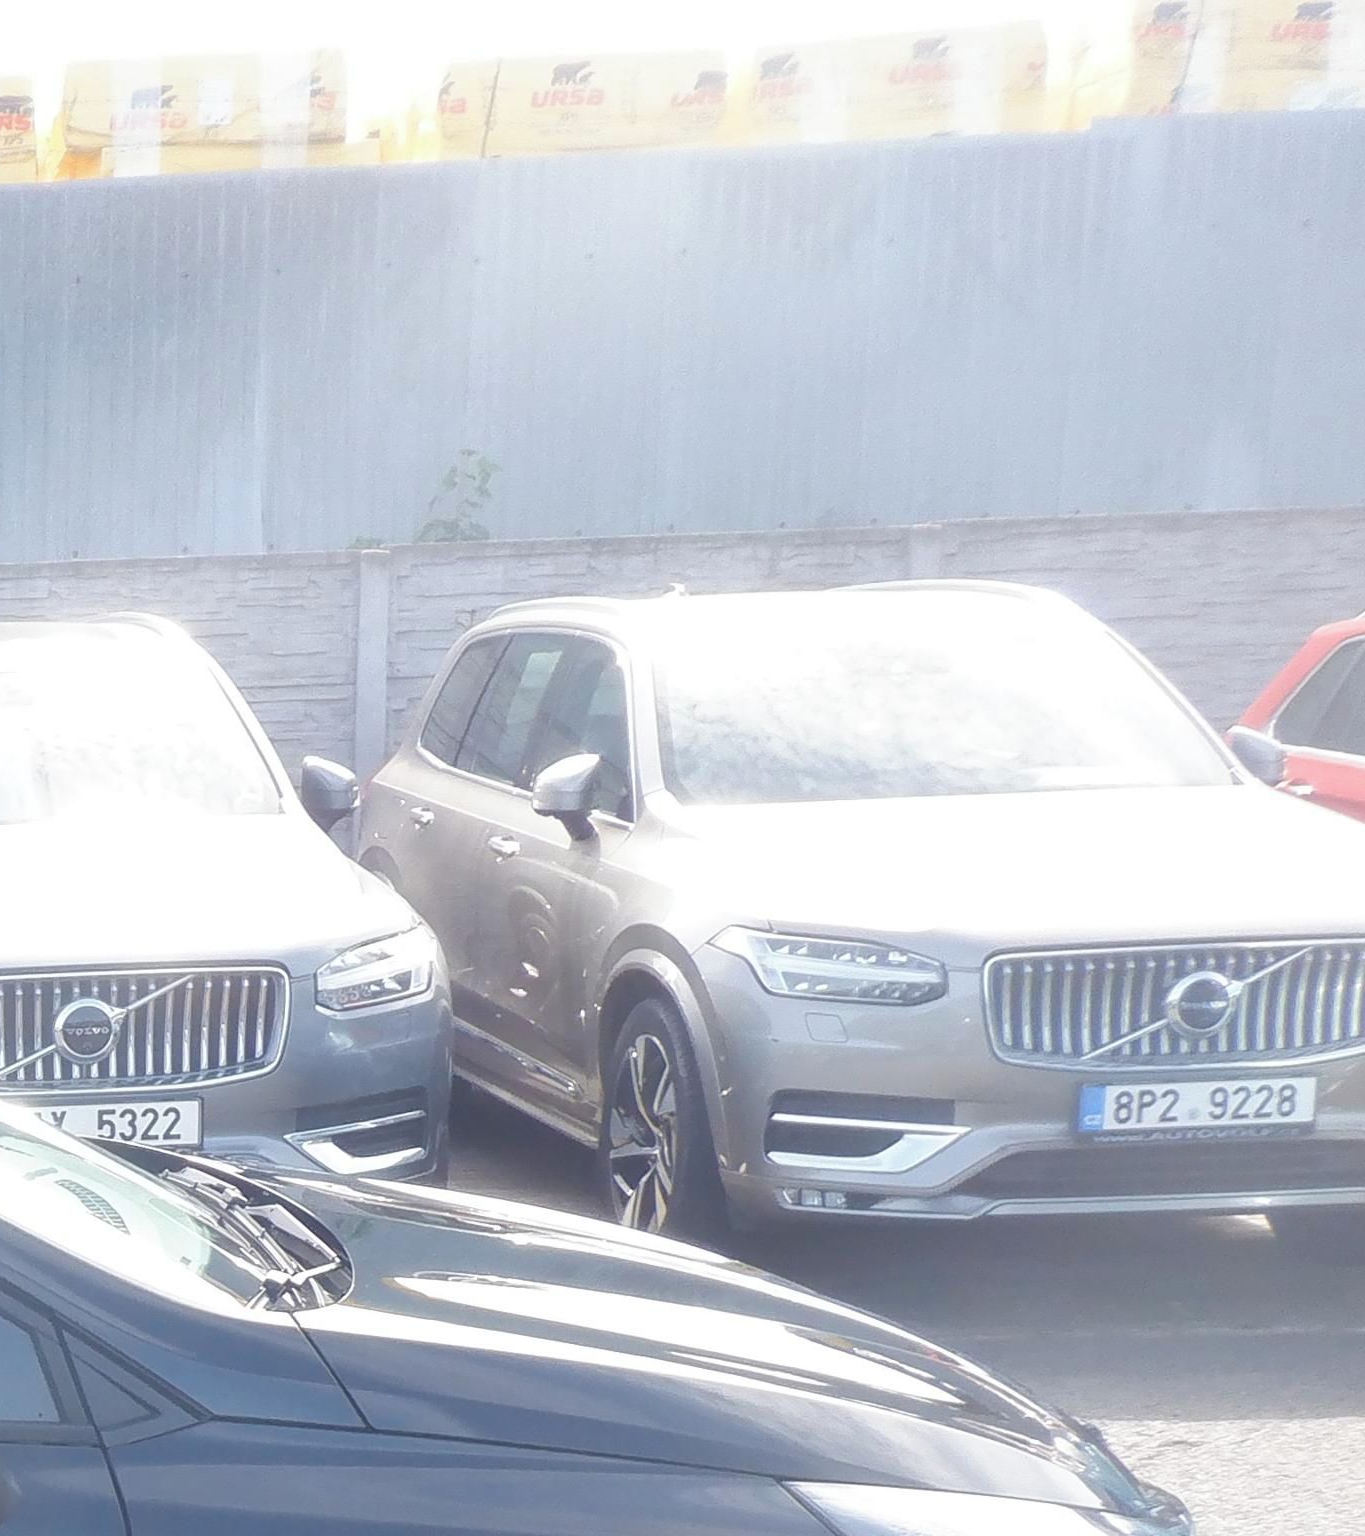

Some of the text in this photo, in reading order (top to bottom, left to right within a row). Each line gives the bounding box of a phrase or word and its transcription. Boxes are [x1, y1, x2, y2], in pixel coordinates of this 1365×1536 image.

[65, 1025, 110, 1036] VOLVO
[1113, 1088, 1180, 1124] 8P2
[1208, 1083, 1298, 1120] 9228
[97, 1106, 181, 1141] 5322
